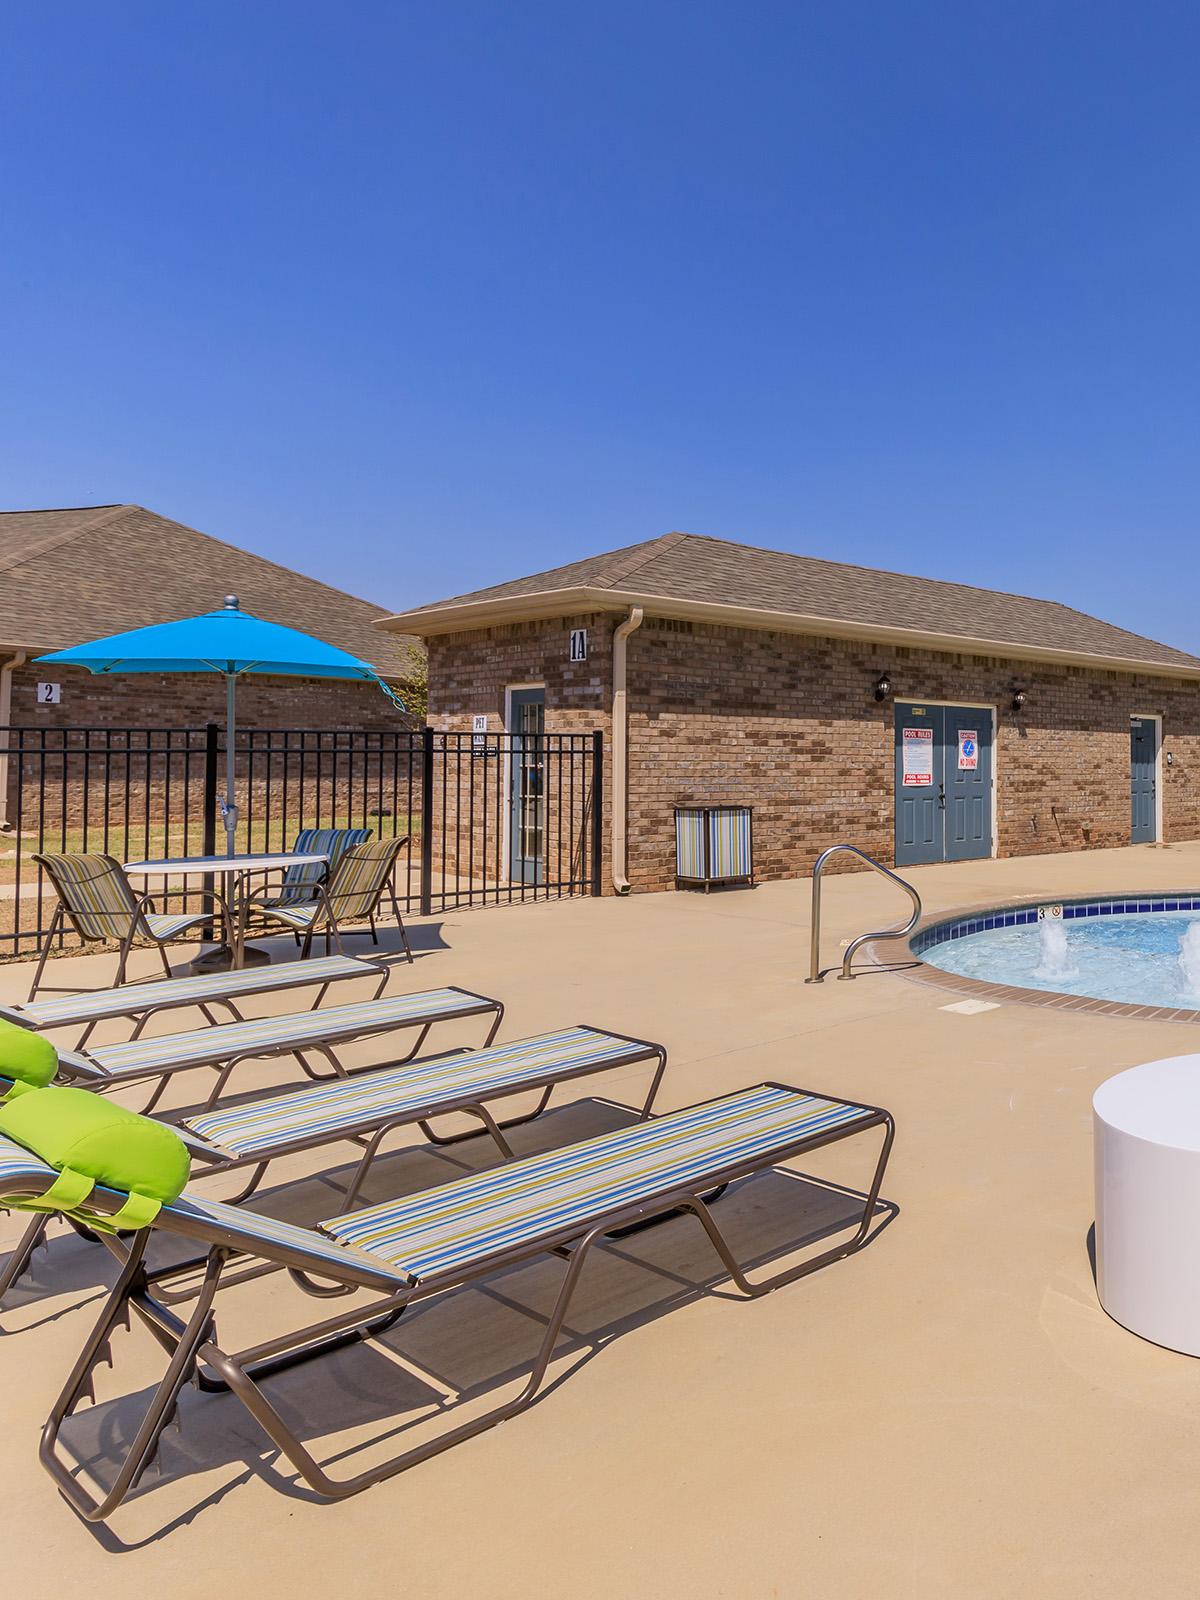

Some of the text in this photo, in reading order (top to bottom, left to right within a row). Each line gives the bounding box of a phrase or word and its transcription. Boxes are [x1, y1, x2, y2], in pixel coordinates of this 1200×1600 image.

[571, 631, 586, 660] 1A
[45, 684, 53, 702] 2
[1039, 908, 1045, 920] 3
